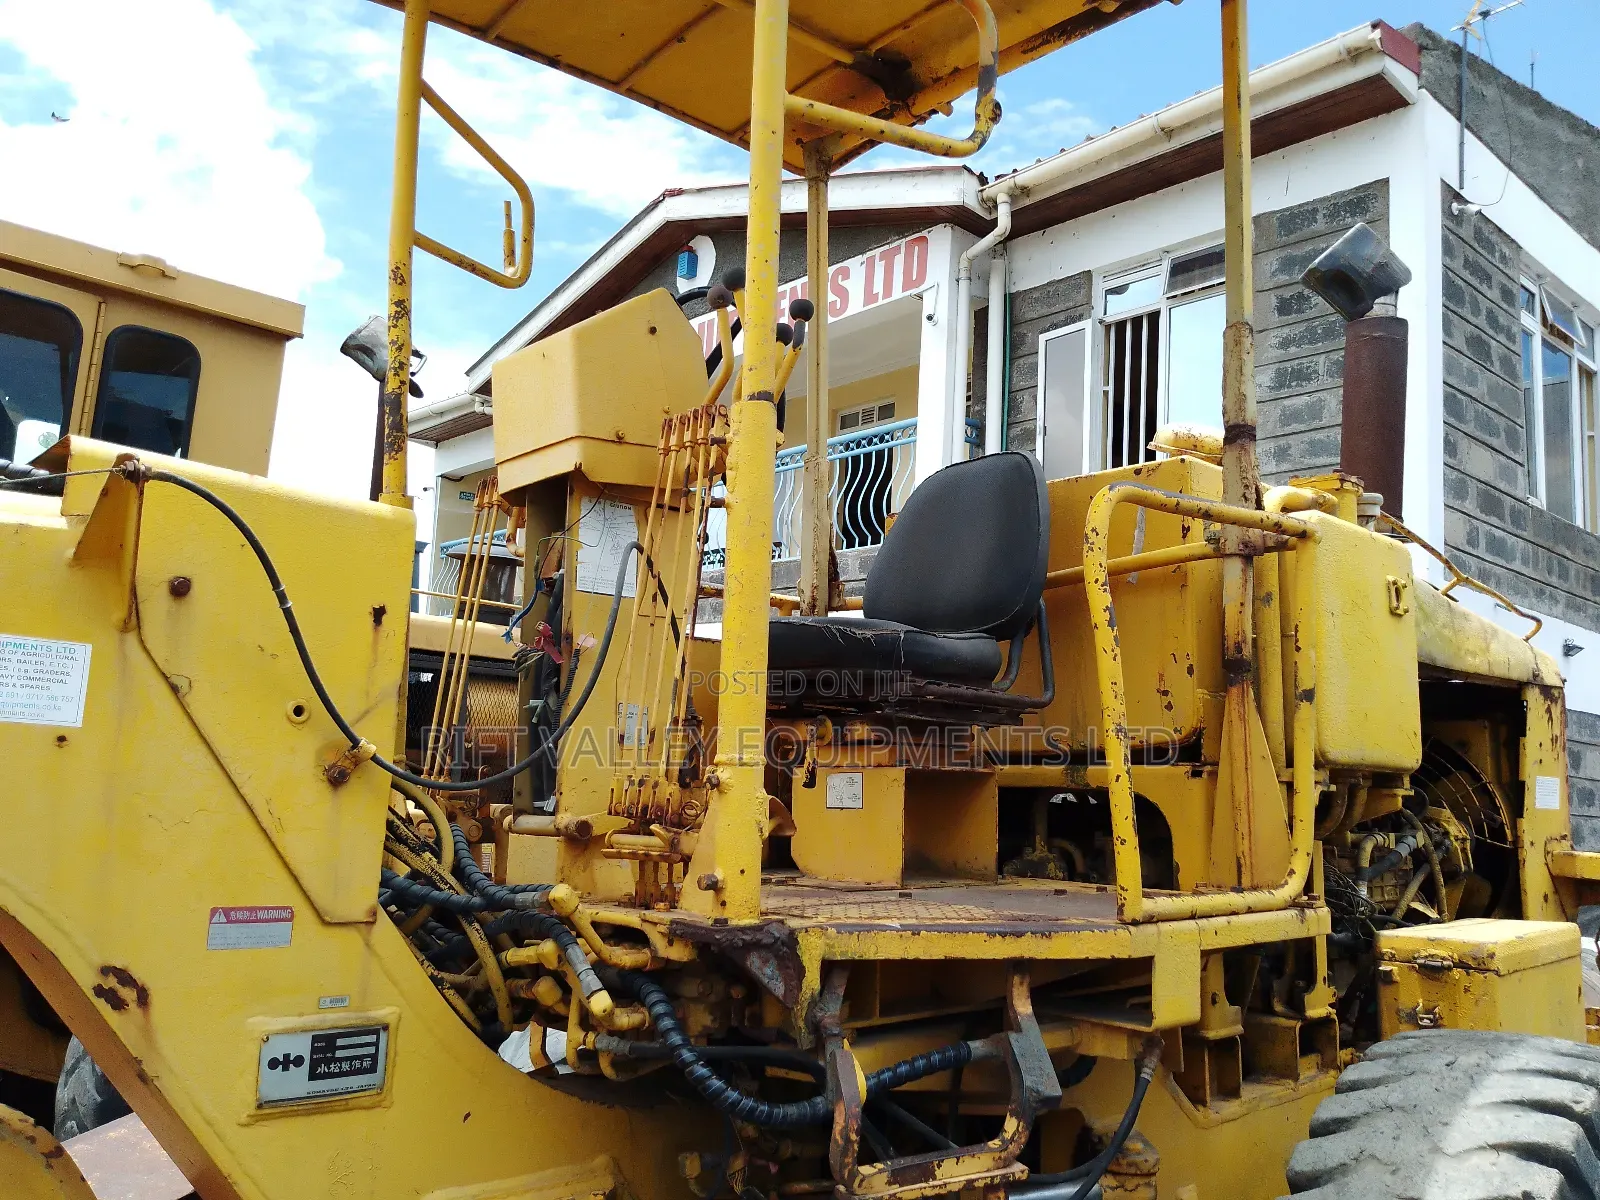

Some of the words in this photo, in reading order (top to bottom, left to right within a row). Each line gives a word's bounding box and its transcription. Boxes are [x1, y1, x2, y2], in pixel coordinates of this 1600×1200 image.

[863, 235, 929, 307] LTD
[610, 503, 632, 511] CAUTION
[0, 641, 52, 653] IPMENTS
[20, 651, 80, 661] AGRICULTURAL
[17, 675, 69, 685] COMMERCIAL
[257, 909, 292, 919] WARNING
[316, 1058, 372, 1073] 小松製作所
